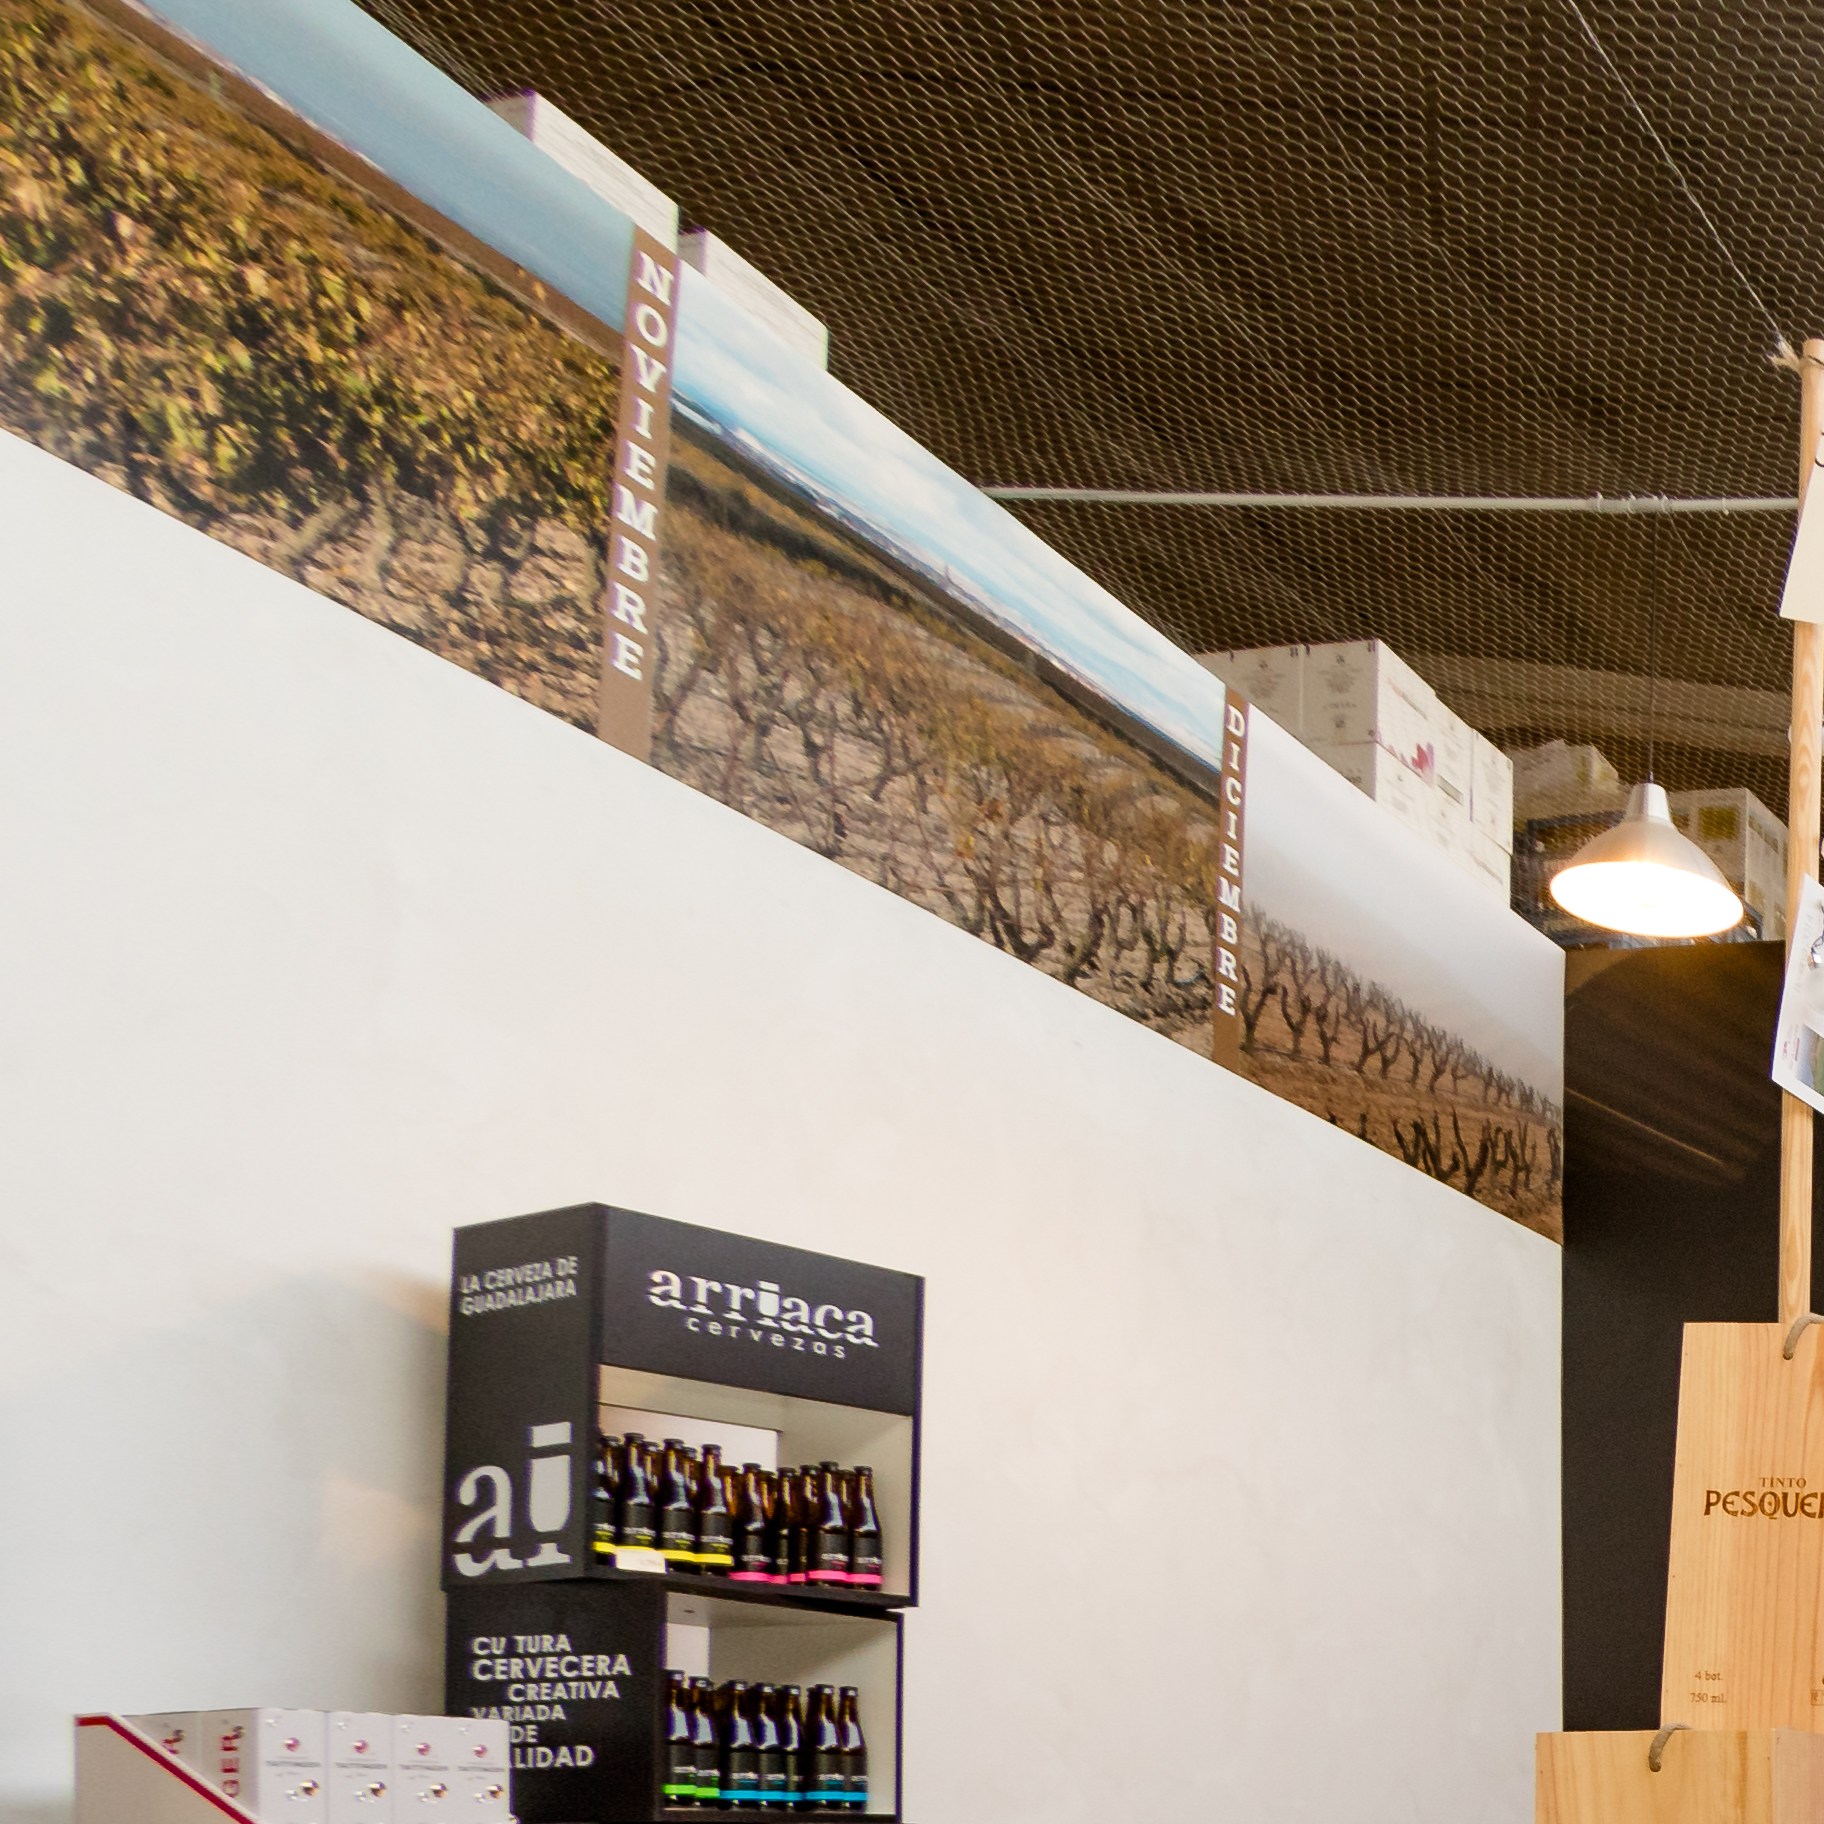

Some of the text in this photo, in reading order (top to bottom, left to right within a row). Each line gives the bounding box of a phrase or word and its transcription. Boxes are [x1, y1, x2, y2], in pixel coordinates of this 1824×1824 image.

[610, 250, 674, 681] NOVIEMBRE
[1217, 703, 1248, 1018] DICIEMBRE
[459, 1255, 579, 1295] LA CERVEZA DE
[459, 1279, 577, 1316] GUADALAJARA
[646, 1269, 880, 1349] arriaca
[685, 1315, 848, 1360] cervezas
[1759, 1476, 1807, 1489] TINTO
[471, 1654, 632, 1682] CERVECERA
[1694, 1670, 1703, 1682] 4
[507, 1681, 621, 1701] CREATIVA
[1690, 1691, 1709, 1704] 750
[470, 1704, 567, 1722] VARIADA
